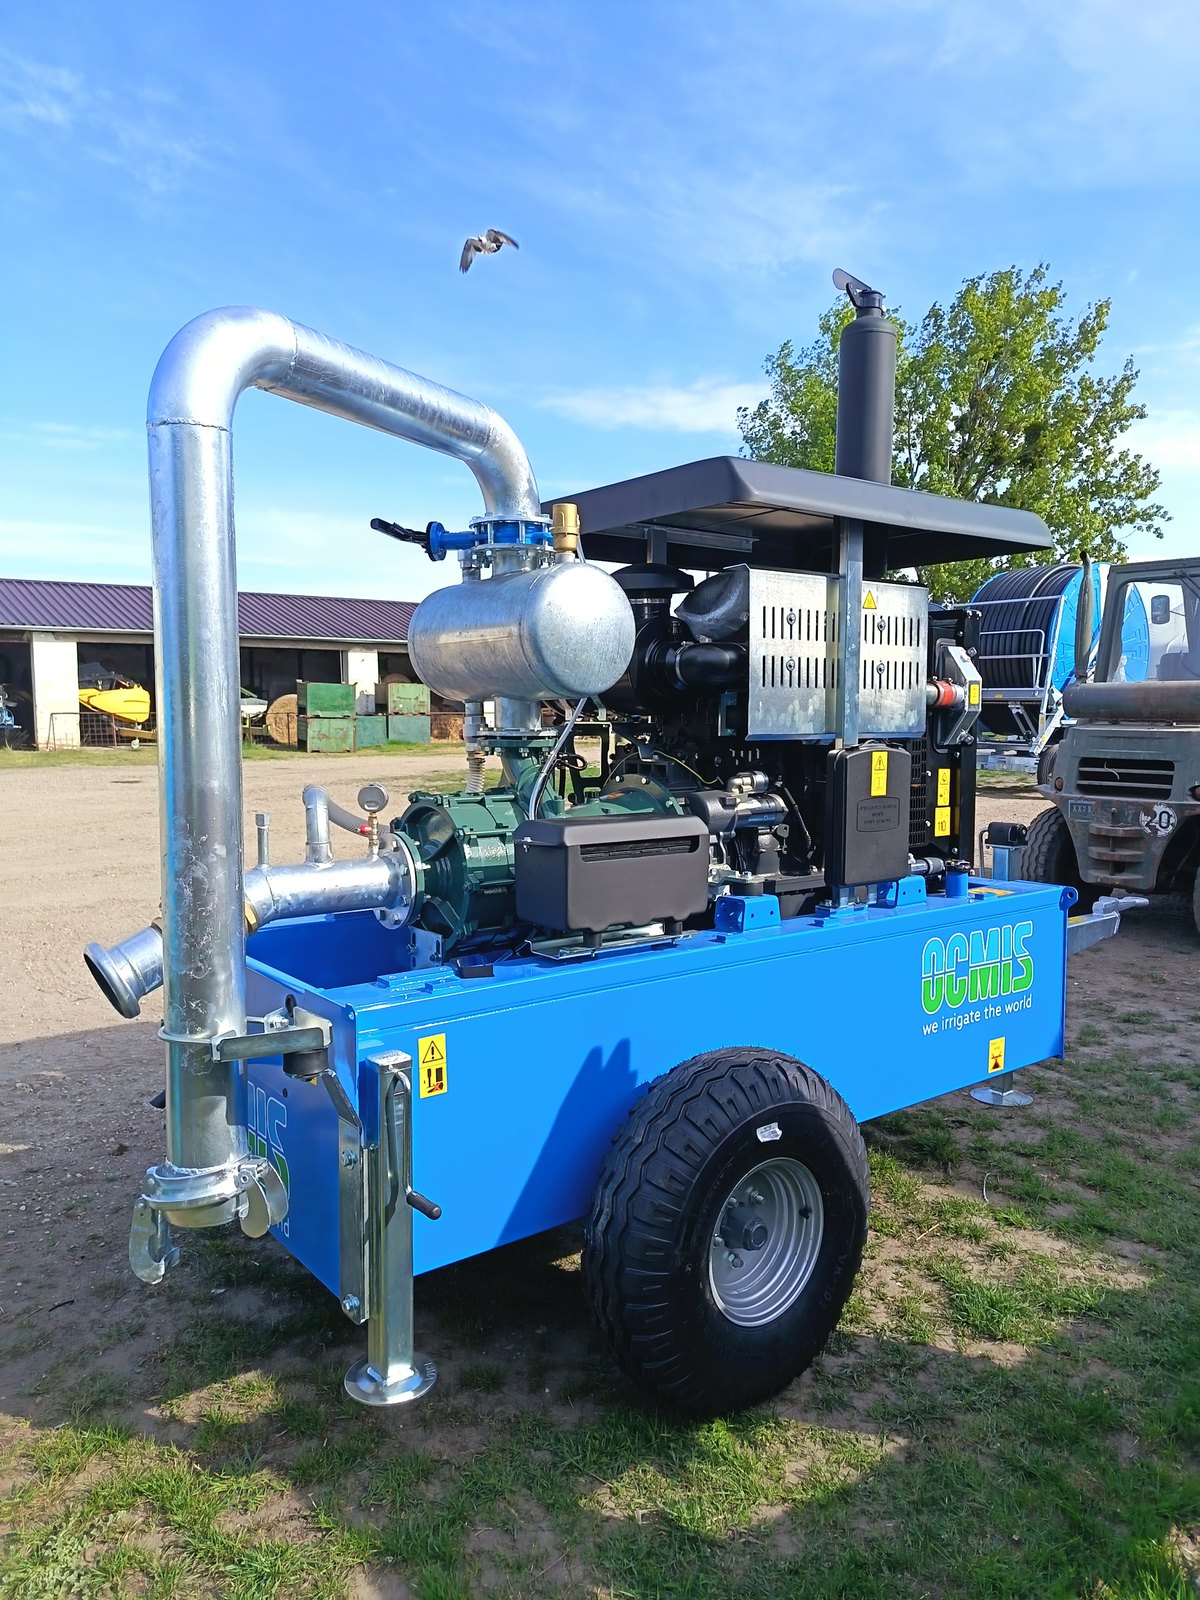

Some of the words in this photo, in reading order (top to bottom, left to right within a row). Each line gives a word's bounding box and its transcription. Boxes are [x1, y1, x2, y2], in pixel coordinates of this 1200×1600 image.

[922, 920, 1034, 1015] OCMIS
[922, 1023, 939, 1036] we
[941, 1009, 981, 1030] irrigate
[984, 1004, 1002, 1020] the
[1005, 993, 1033, 1014] world
